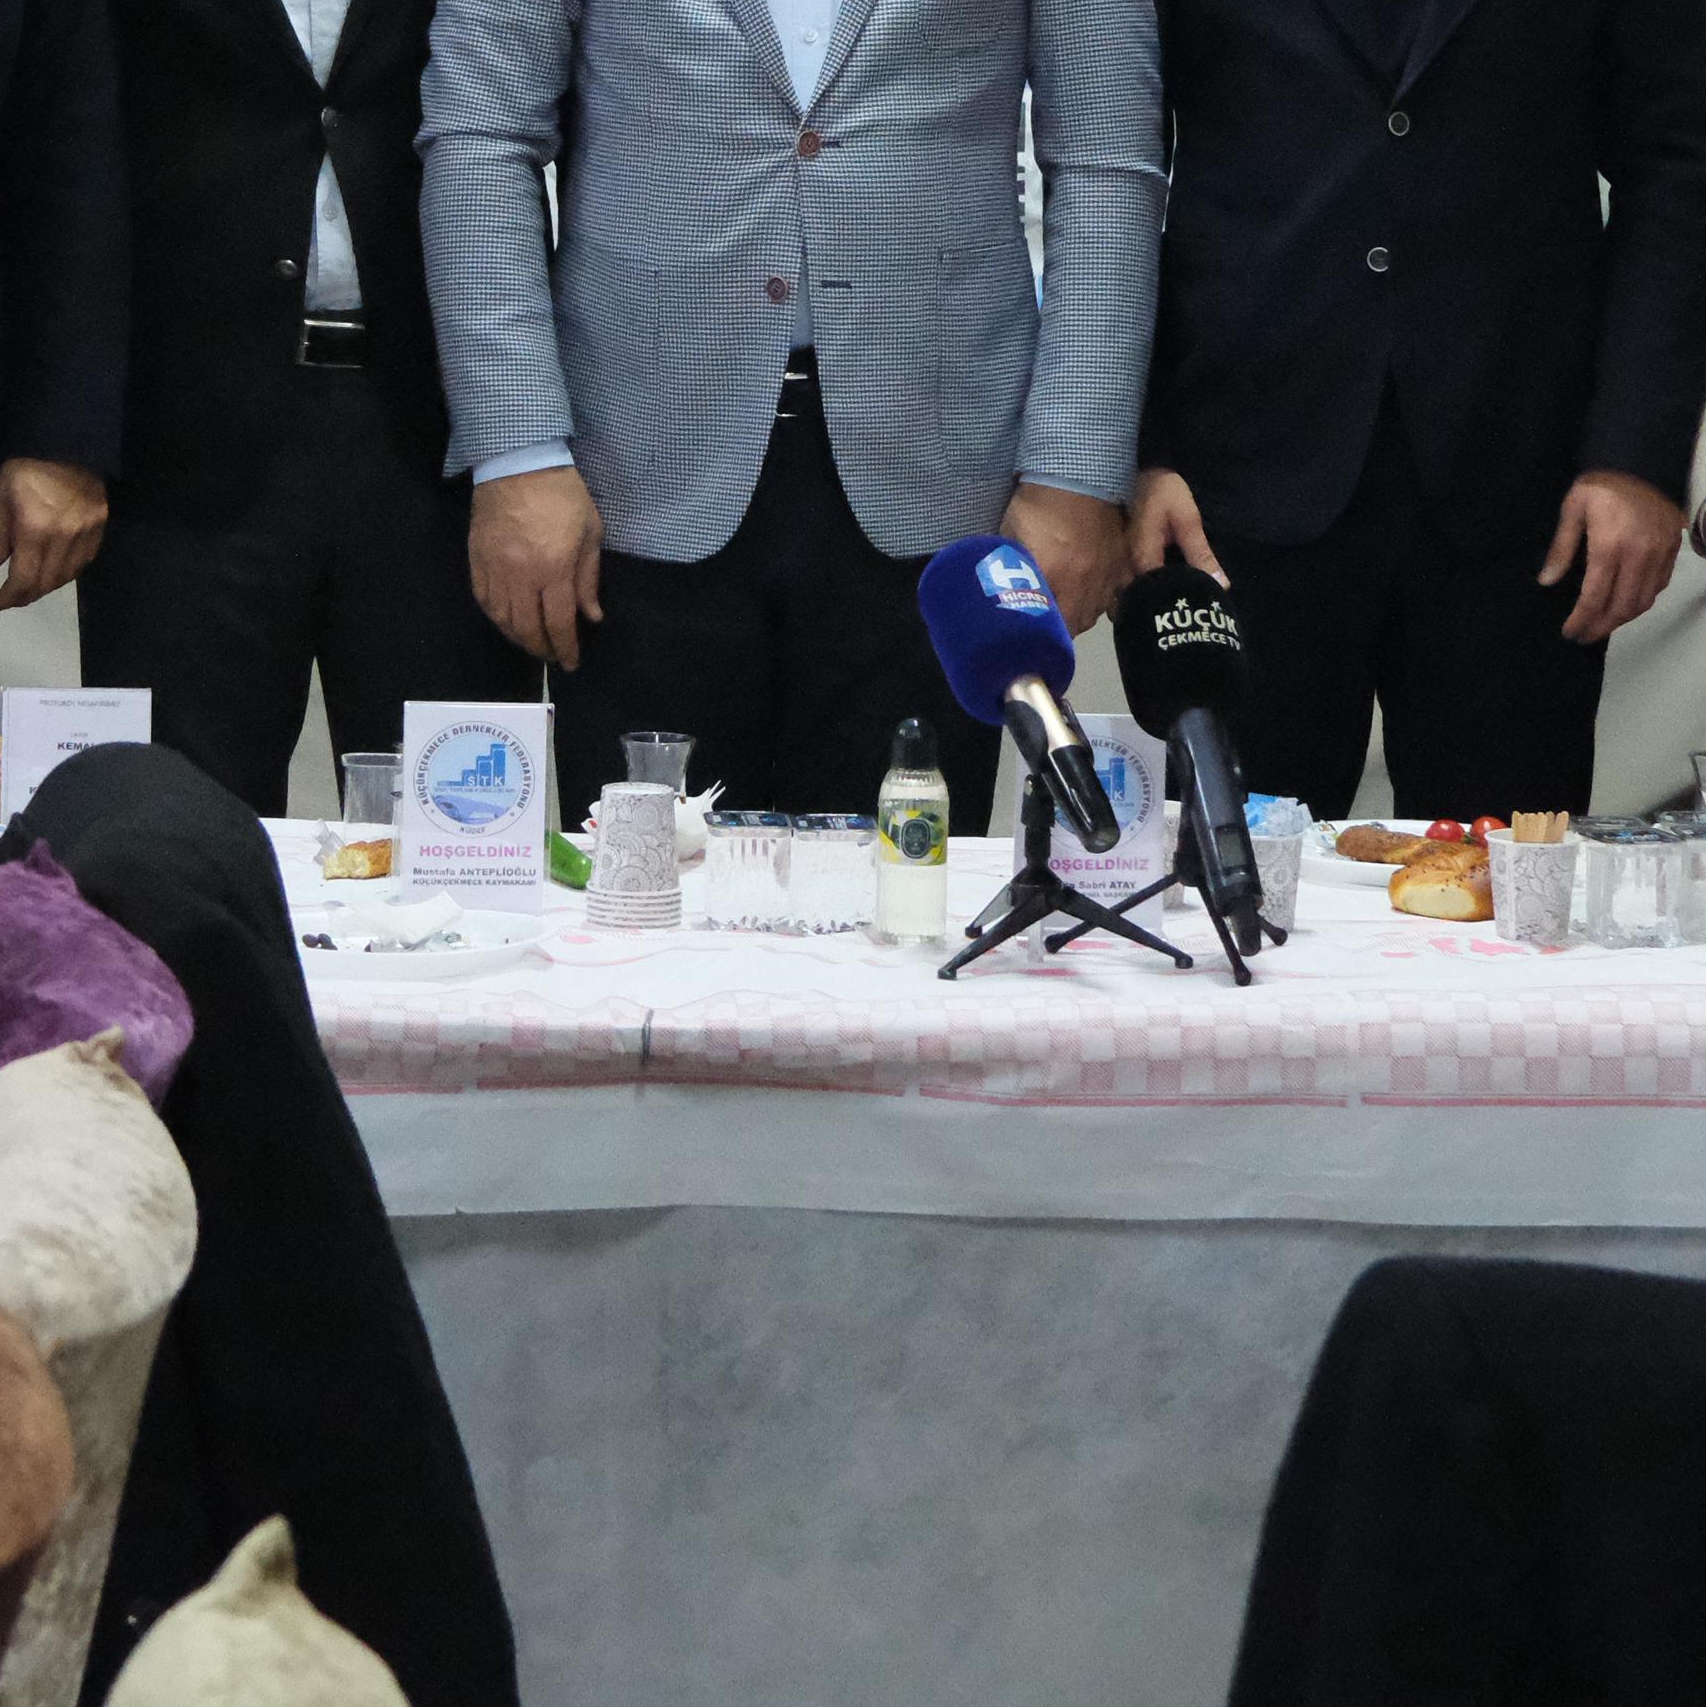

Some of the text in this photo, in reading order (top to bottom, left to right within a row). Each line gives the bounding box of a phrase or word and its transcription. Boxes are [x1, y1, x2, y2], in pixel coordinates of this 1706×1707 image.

[1002, 591, 1049, 604] HİCRET
[1158, 631, 1227, 651] ÇEKMECE
[451, 724, 510, 743] DERNEKLER
[467, 775, 504, 787] STK
[419, 844, 532, 859] HOŞGELDİNİZ
[412, 866, 537, 877] Mustafa ANTEPLİOĞLU
[1049, 856, 1150, 875] OŞGELDİNİZ
[1109, 881, 1137, 890] ATAY
